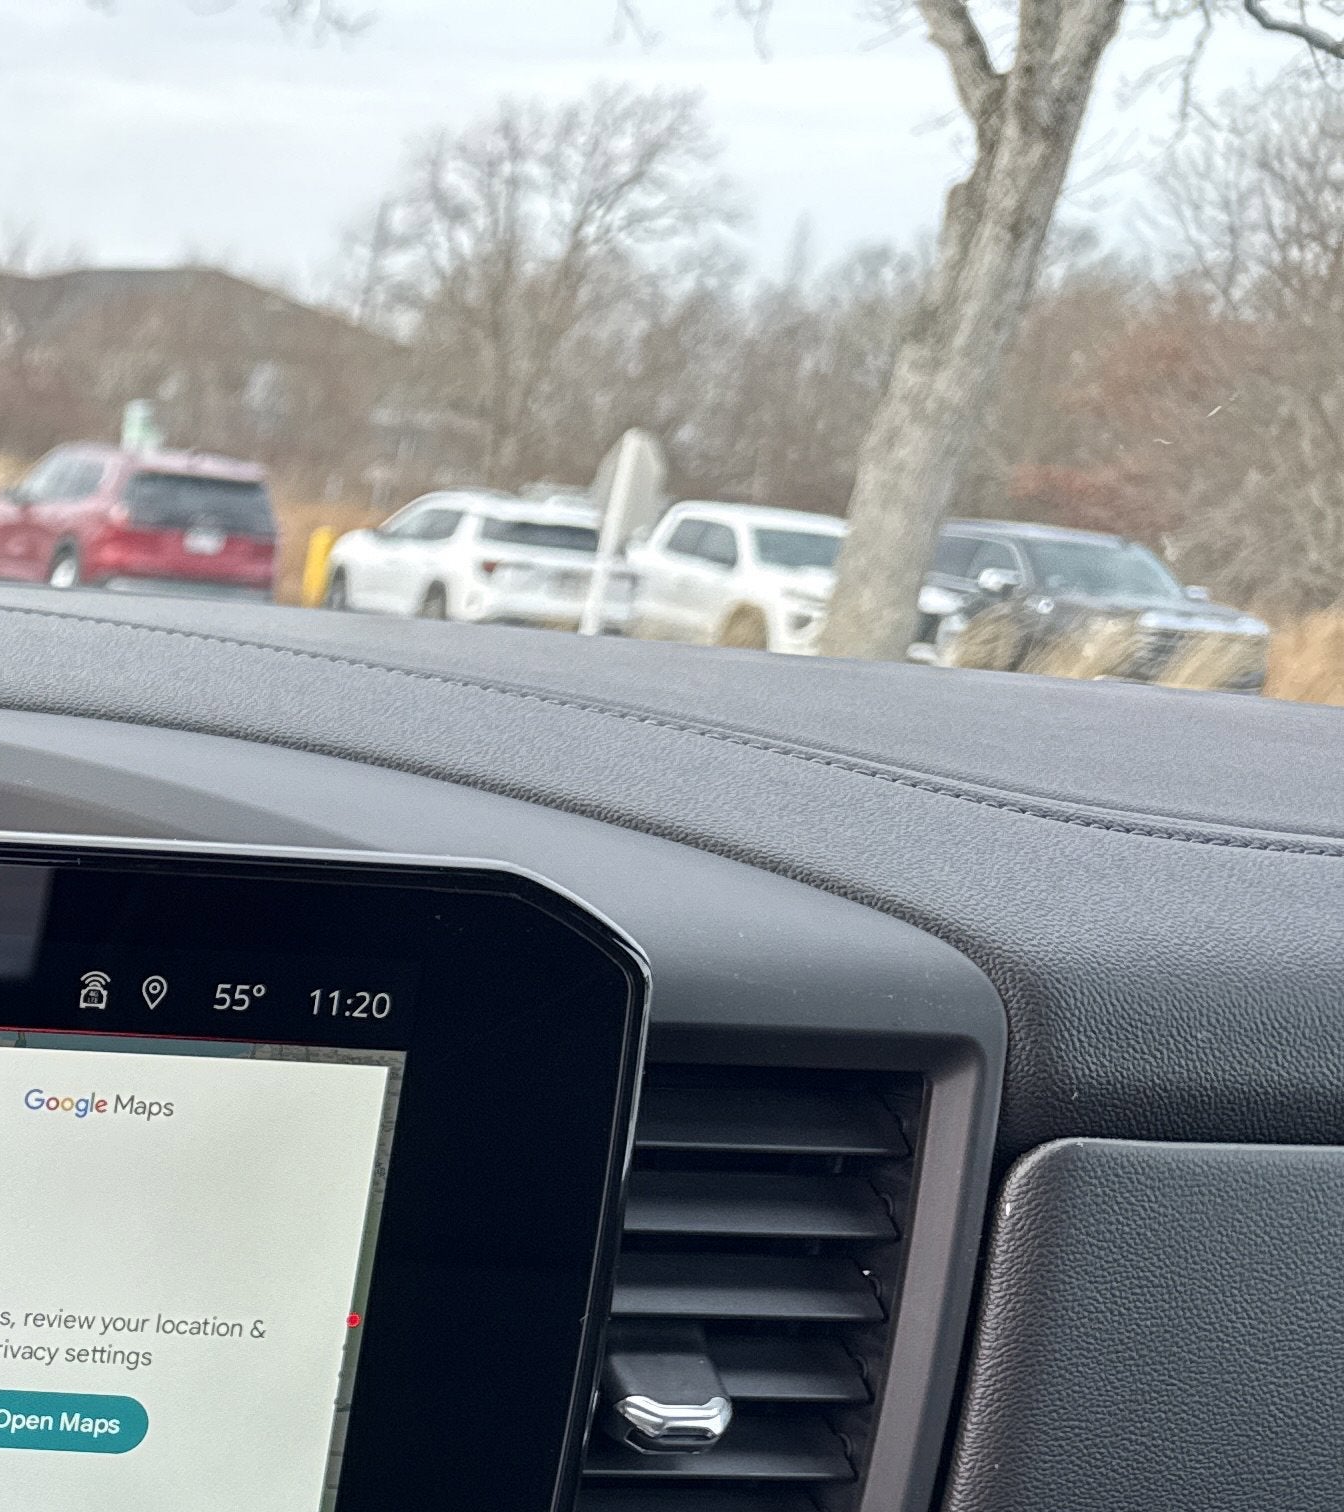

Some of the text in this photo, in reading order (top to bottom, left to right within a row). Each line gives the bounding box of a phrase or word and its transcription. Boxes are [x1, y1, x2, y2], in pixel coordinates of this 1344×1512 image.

[310, 989, 391, 1019] 11:20
[24, 1088, 175, 1122] Google Maps
[23, 1308, 96, 1330] review
[98, 1316, 151, 1336] your
[155, 1313, 243, 1338] location
[249, 1319, 267, 1339] &
[64, 1343, 153, 1371] settings
[58, 1411, 121, 1439] Maps
